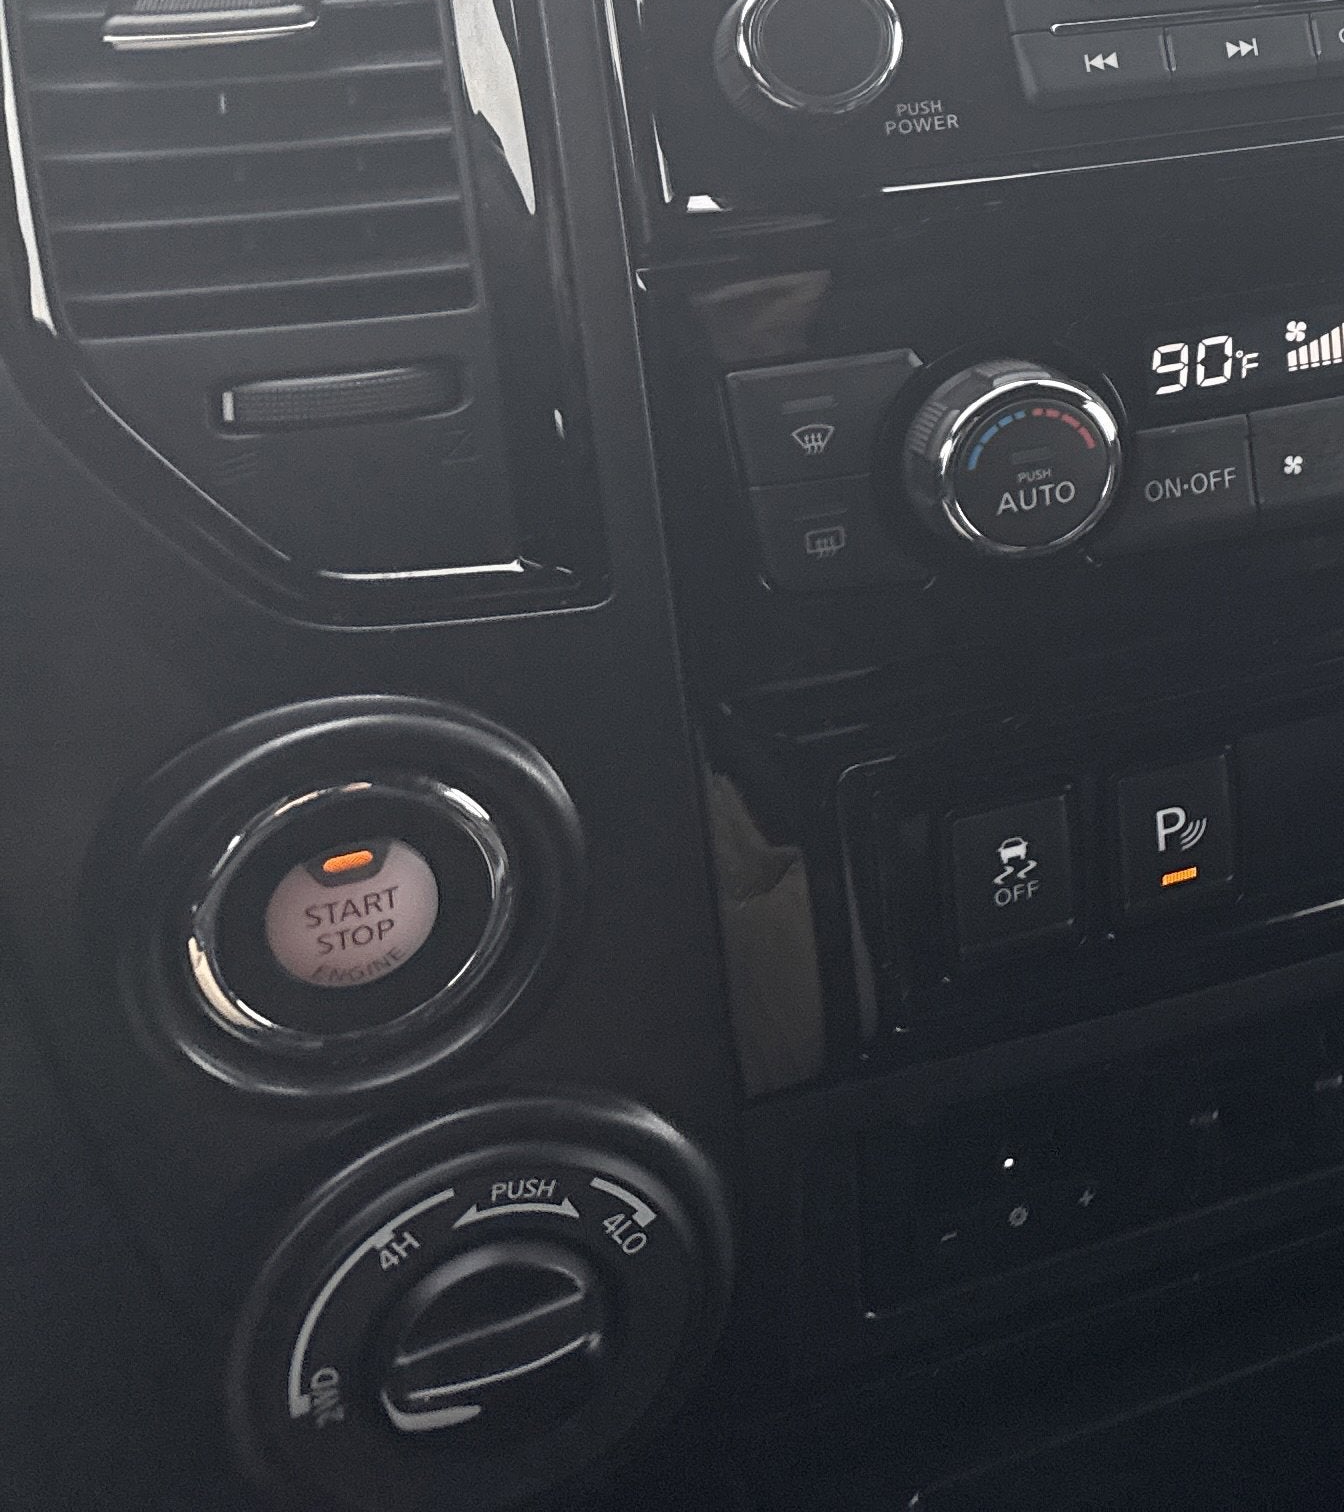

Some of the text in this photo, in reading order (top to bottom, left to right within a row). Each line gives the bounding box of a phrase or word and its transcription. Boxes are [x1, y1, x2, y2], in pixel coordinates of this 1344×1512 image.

[895, 99, 944, 117] PUSH
[884, 113, 960, 136] POWER
[1017, 467, 1052, 484] PUSH
[996, 480, 1077, 516] AUTO
[304, 885, 400, 929] START
[994, 880, 1041, 907] OFF
[317, 918, 395, 955] STOP
[313, 949, 403, 982] ENGINE
[490, 1178, 557, 1203] PUSH
[378, 1231, 421, 1272] 4H
